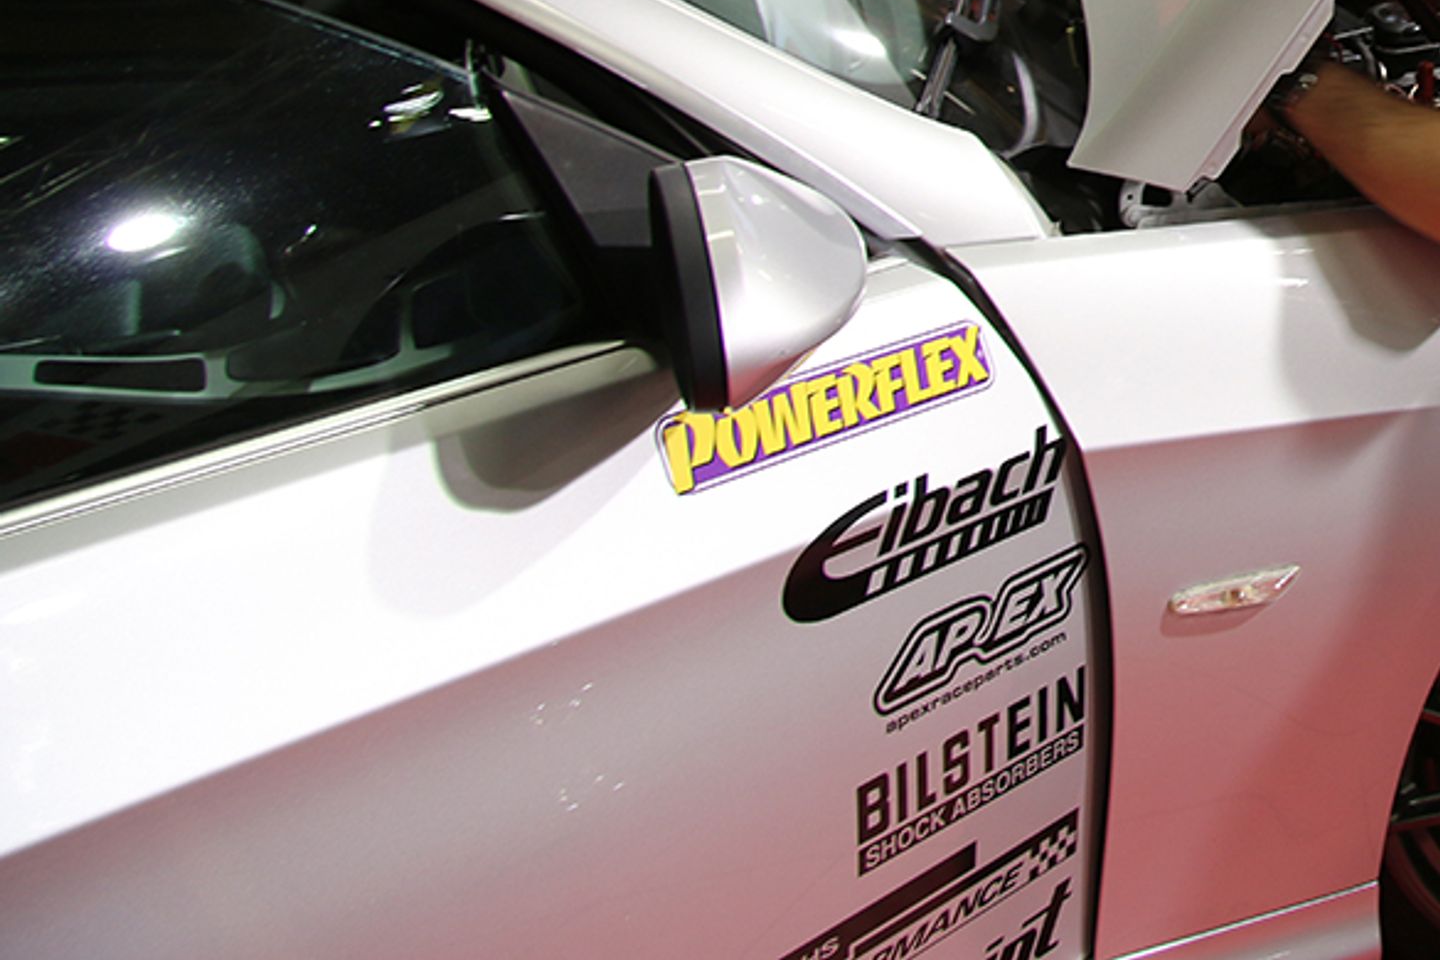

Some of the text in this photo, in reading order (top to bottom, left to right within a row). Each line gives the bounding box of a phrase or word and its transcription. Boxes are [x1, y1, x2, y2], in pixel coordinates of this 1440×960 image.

[663, 324, 988, 495] POWERFLEX
[782, 424, 1067, 624] Eibach
[856, 665, 1086, 846] BILSTEIN
[886, 632, 1068, 735] apexraceparts.com
[864, 730, 1080, 871] SHOCK ABSORBERS
